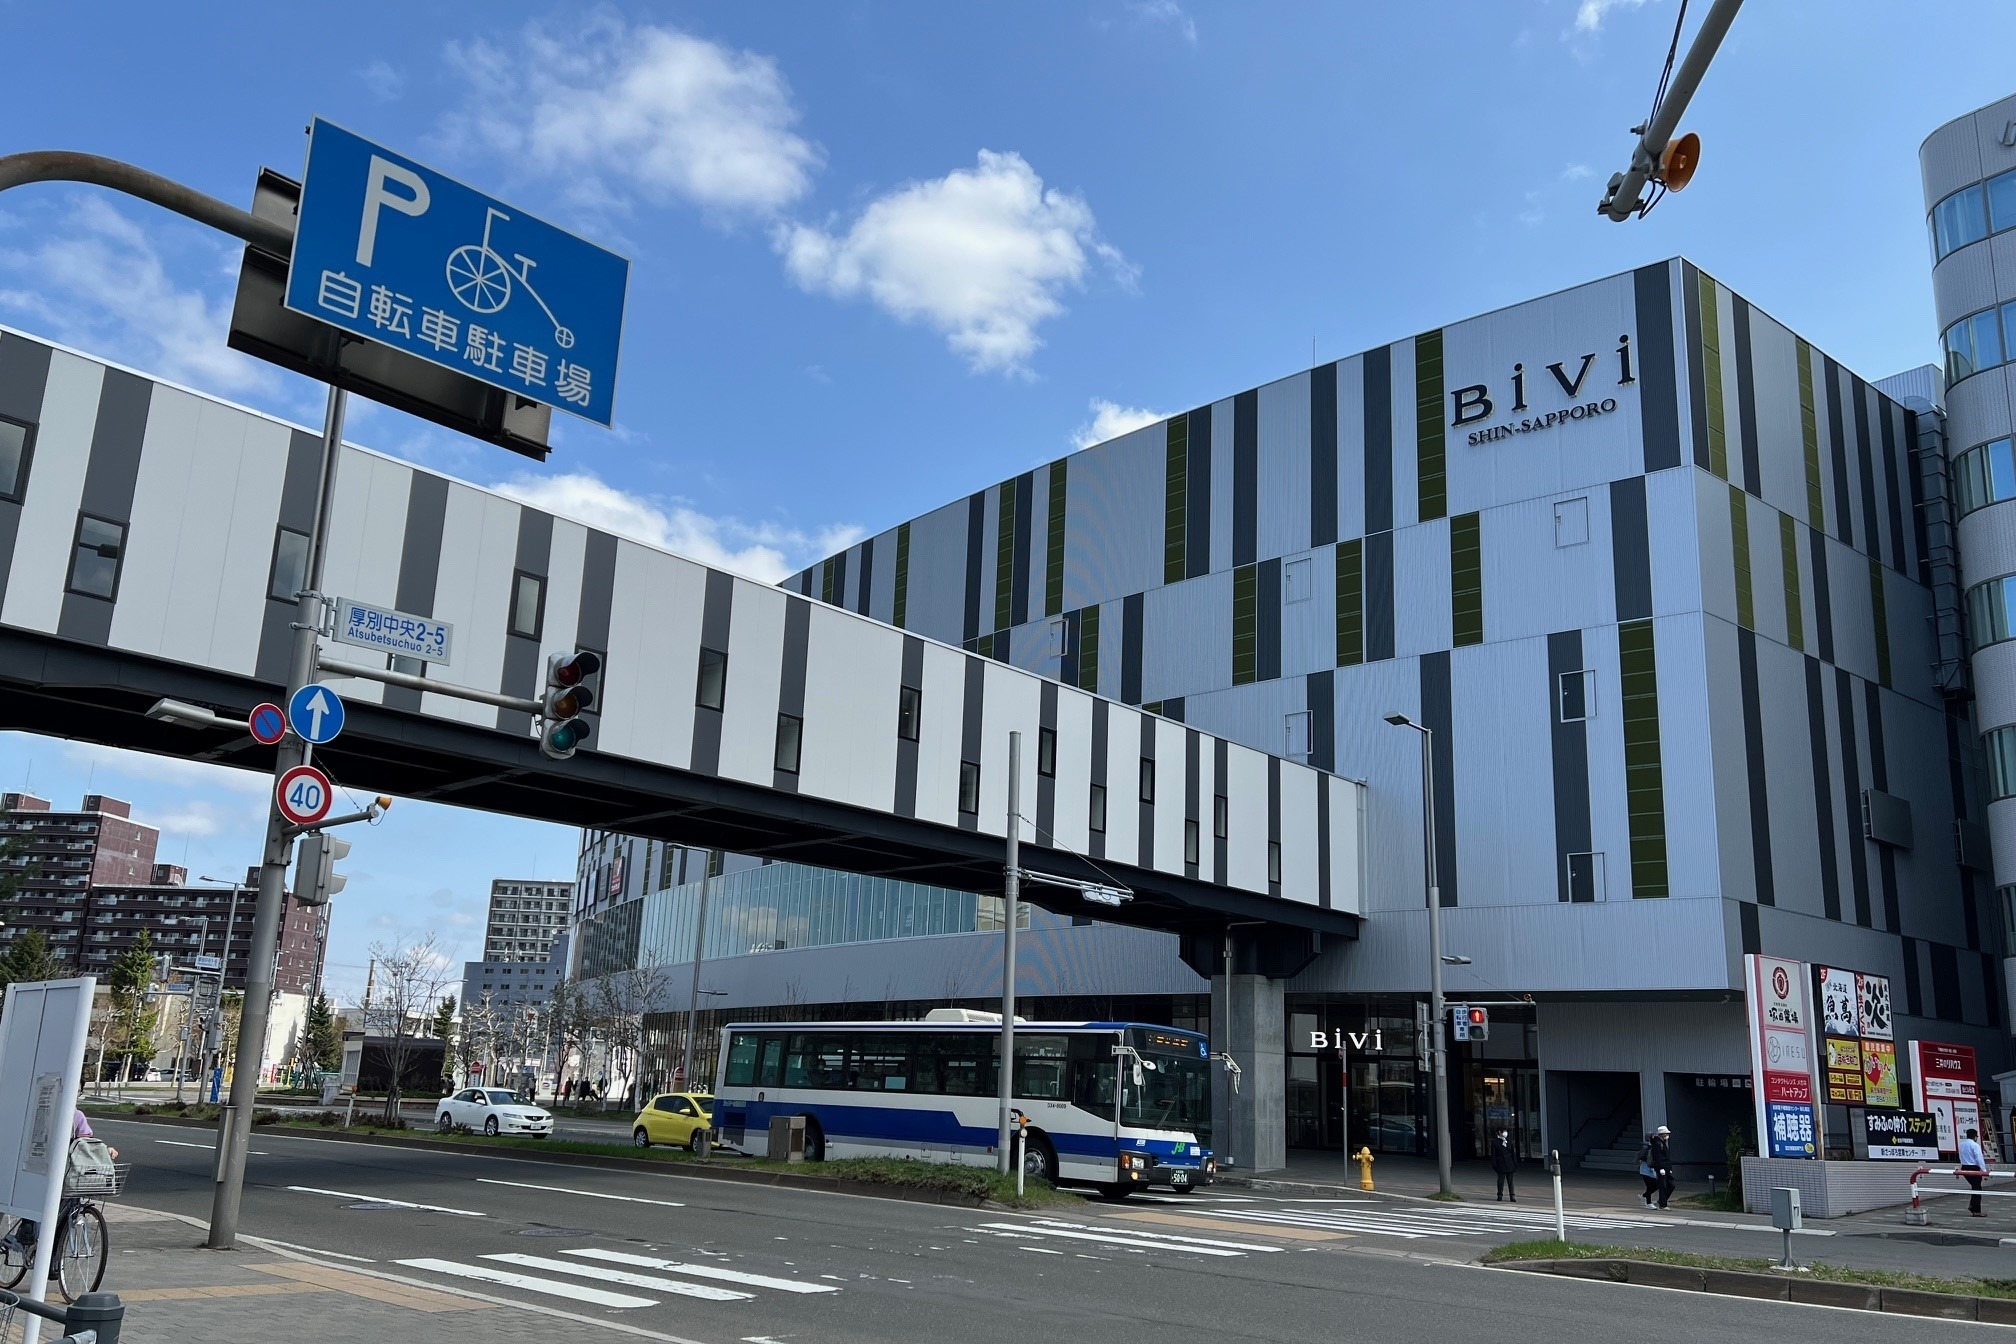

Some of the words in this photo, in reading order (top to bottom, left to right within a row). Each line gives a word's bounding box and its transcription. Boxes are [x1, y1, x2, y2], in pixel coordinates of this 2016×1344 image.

[356, 153, 431, 267] P
[317, 270, 593, 408] 自転車駐車場
[1467, 397, 1619, 447] SHIN-SAPPORO
[348, 606, 445, 646] 厚別中央2-5
[347, 626, 422, 652] Atsubetsuchuo
[425, 644, 444, 657] 2-5
[289, 782, 321, 810] 40
[1695, 1077, 1729, 1088] 駐輪場
[1781, 1086, 1808, 1099] ハートアップ
[1773, 1112, 1812, 1142] 補聴器
[1867, 1114, 1907, 1134] すみふの仲介
[1908, 1117, 1933, 1134] ステップ
